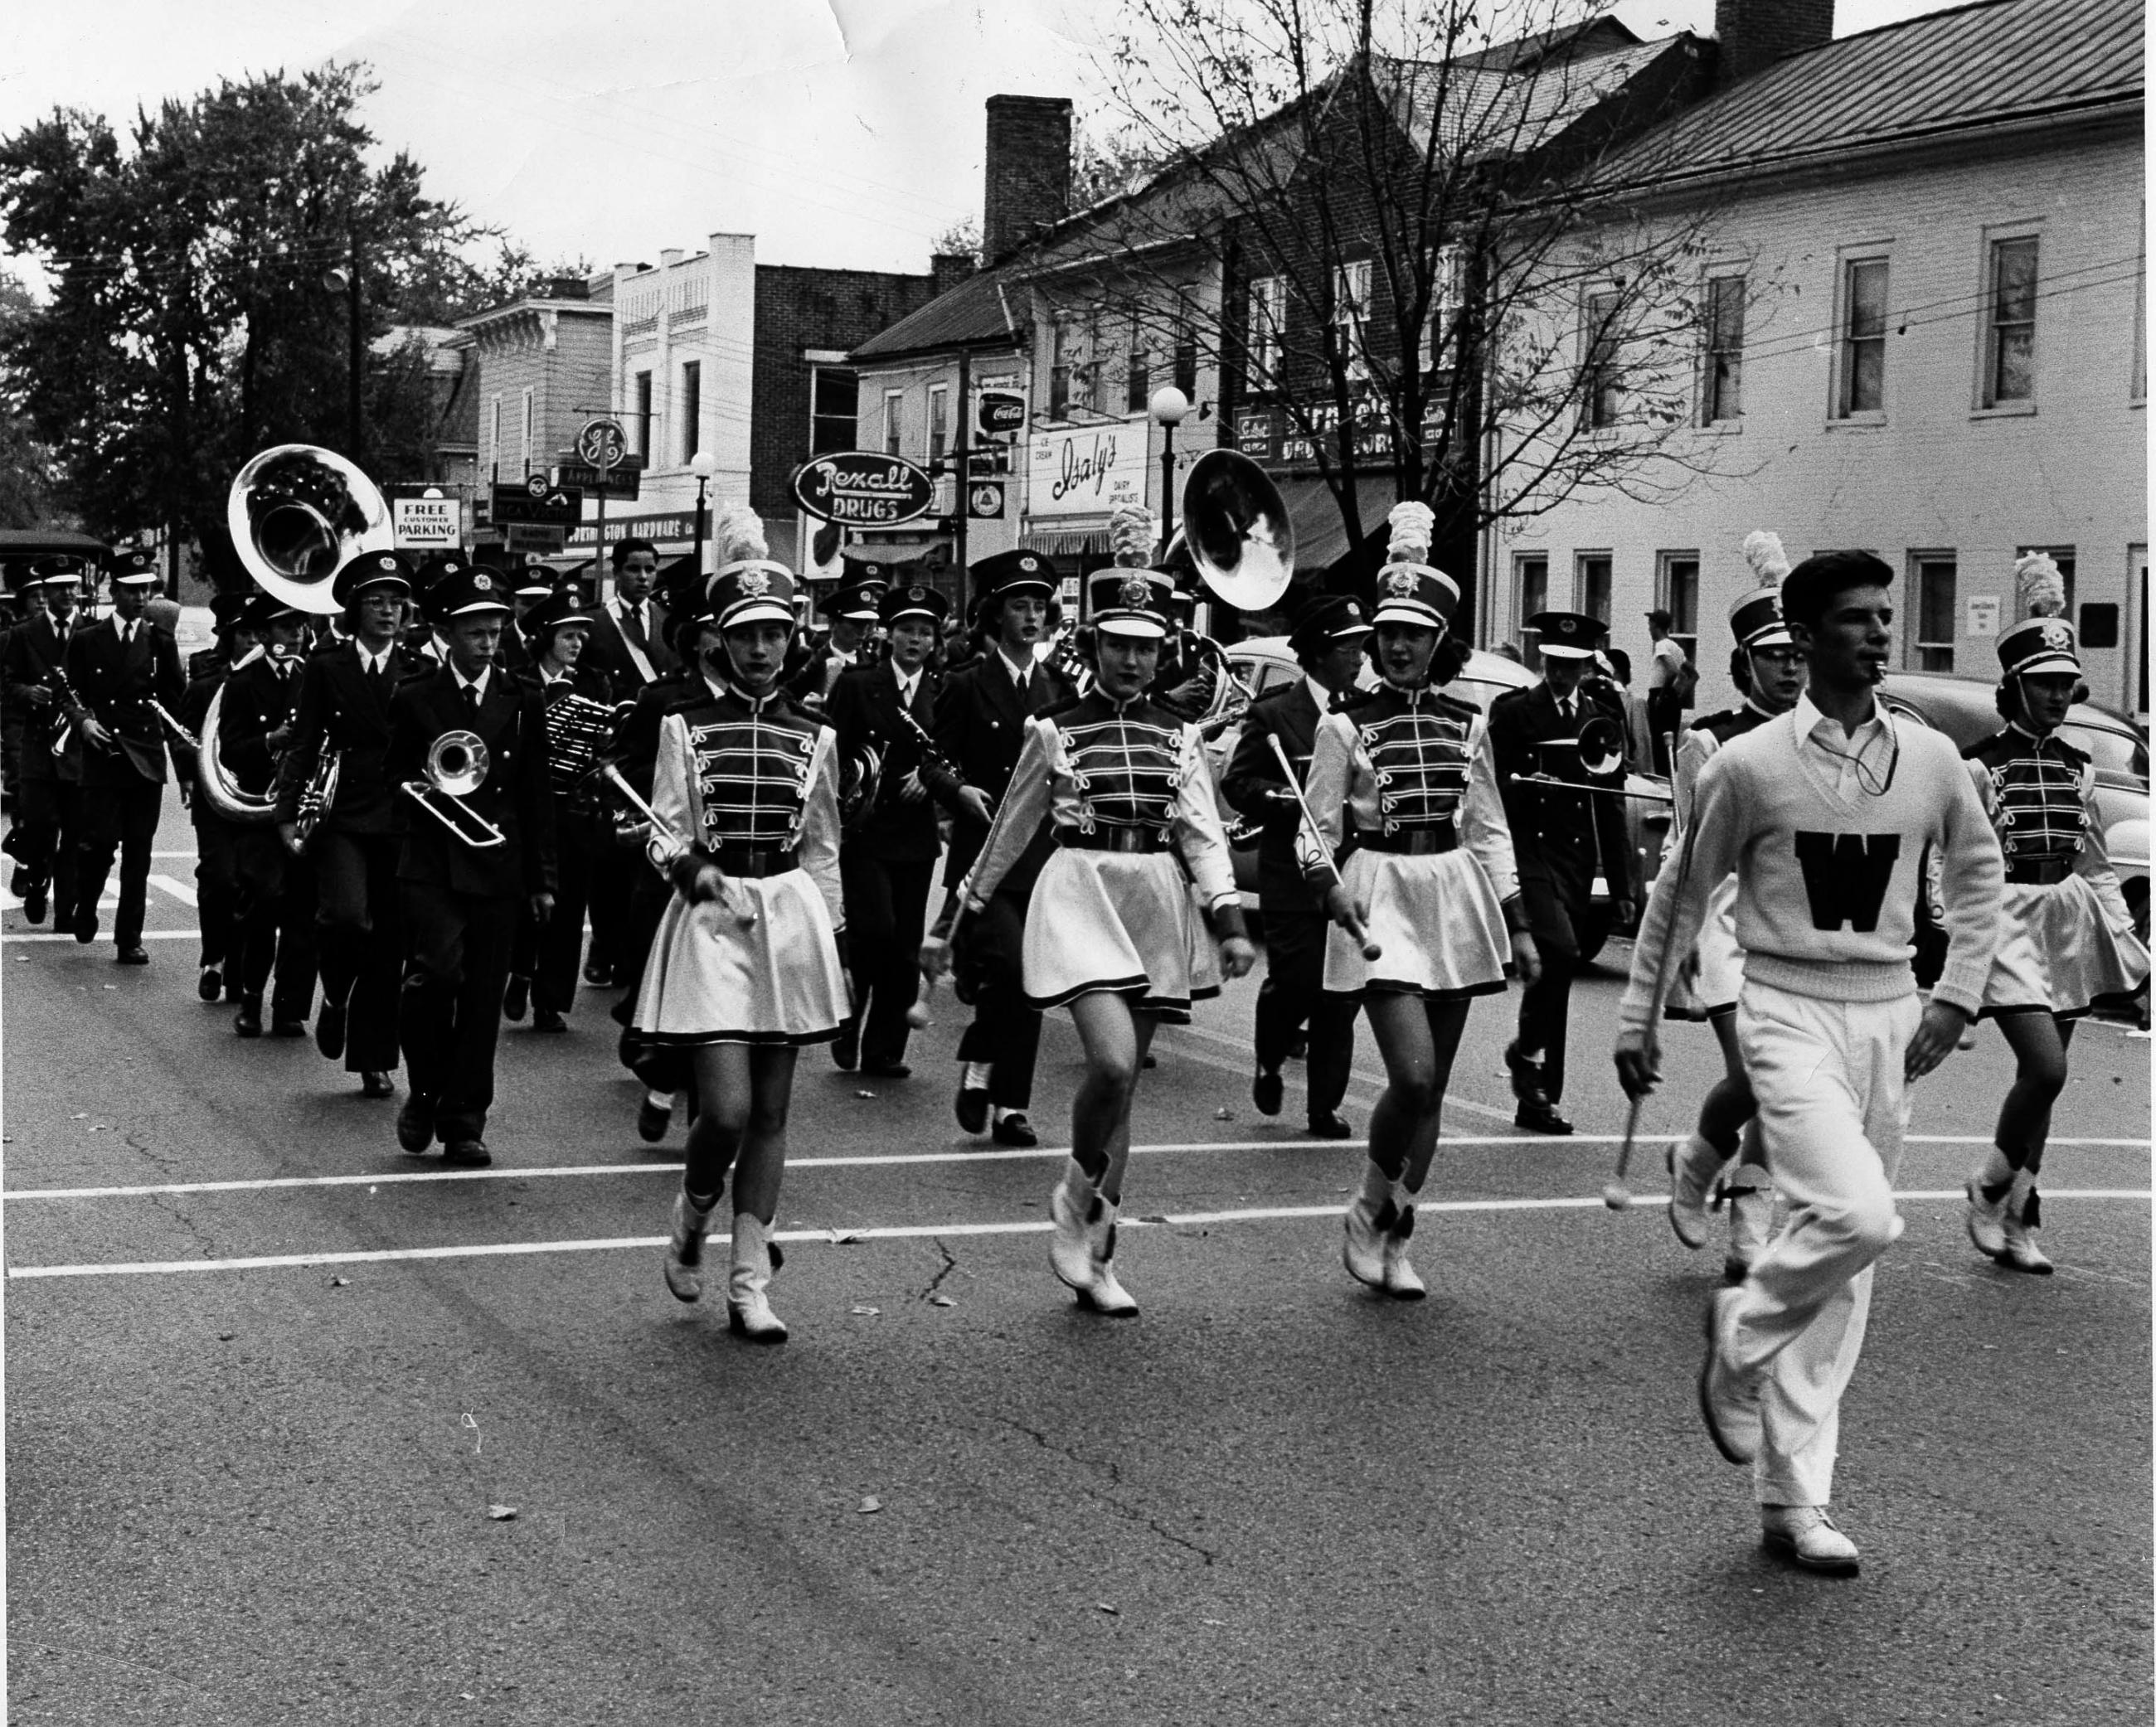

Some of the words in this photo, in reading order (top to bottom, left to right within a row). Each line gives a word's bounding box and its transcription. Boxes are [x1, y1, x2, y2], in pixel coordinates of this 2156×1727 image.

[815, 462, 913, 497] Rexall
[405, 504, 447, 515] FREE
[833, 497, 898, 519] DRUGS
[398, 524, 456, 536] PARKING
[632, 520, 681, 538] HARDWARE
[1794, 830, 1901, 934] W
